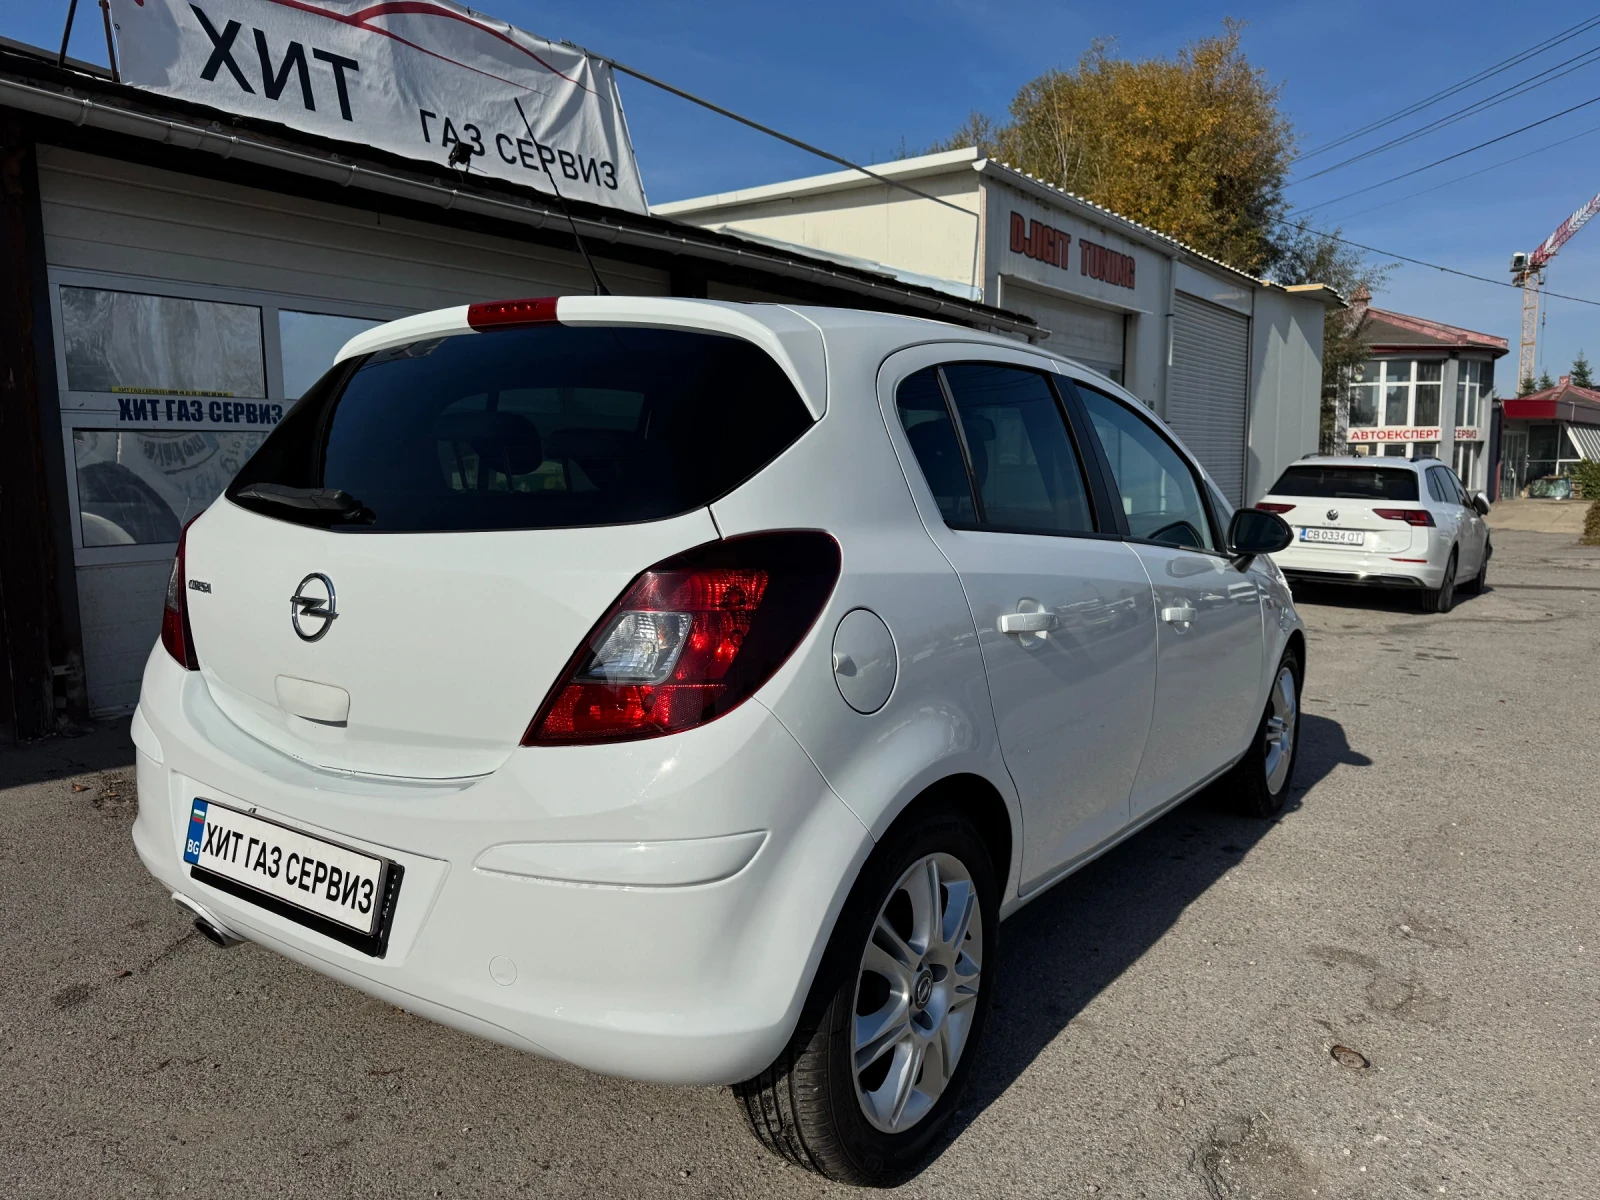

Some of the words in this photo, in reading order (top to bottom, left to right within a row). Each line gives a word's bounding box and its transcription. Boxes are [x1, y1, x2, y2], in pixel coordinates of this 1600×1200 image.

[189, 3, 359, 122] ХИТ
[419, 109, 485, 156] ГАЗ
[495, 133, 618, 190] СЕРВИЗ
[1010, 210, 1071, 271] DJIGIT
[1079, 238, 1135, 290] TUNING
[118, 398, 160, 421] ХИТ
[165, 400, 203, 422] ГАЗ
[208, 401, 283, 425] СЕРВИЗ
[1351, 429, 1440, 440] АВТОЕКСПЕРТ
[1321, 530, 1346, 542] 0334
[187, 839, 201, 856] BG
[202, 822, 244, 864] ХИТ
[244, 836, 282, 879] ГАЗ
[285, 852, 374, 915] СЕРВИЗ
